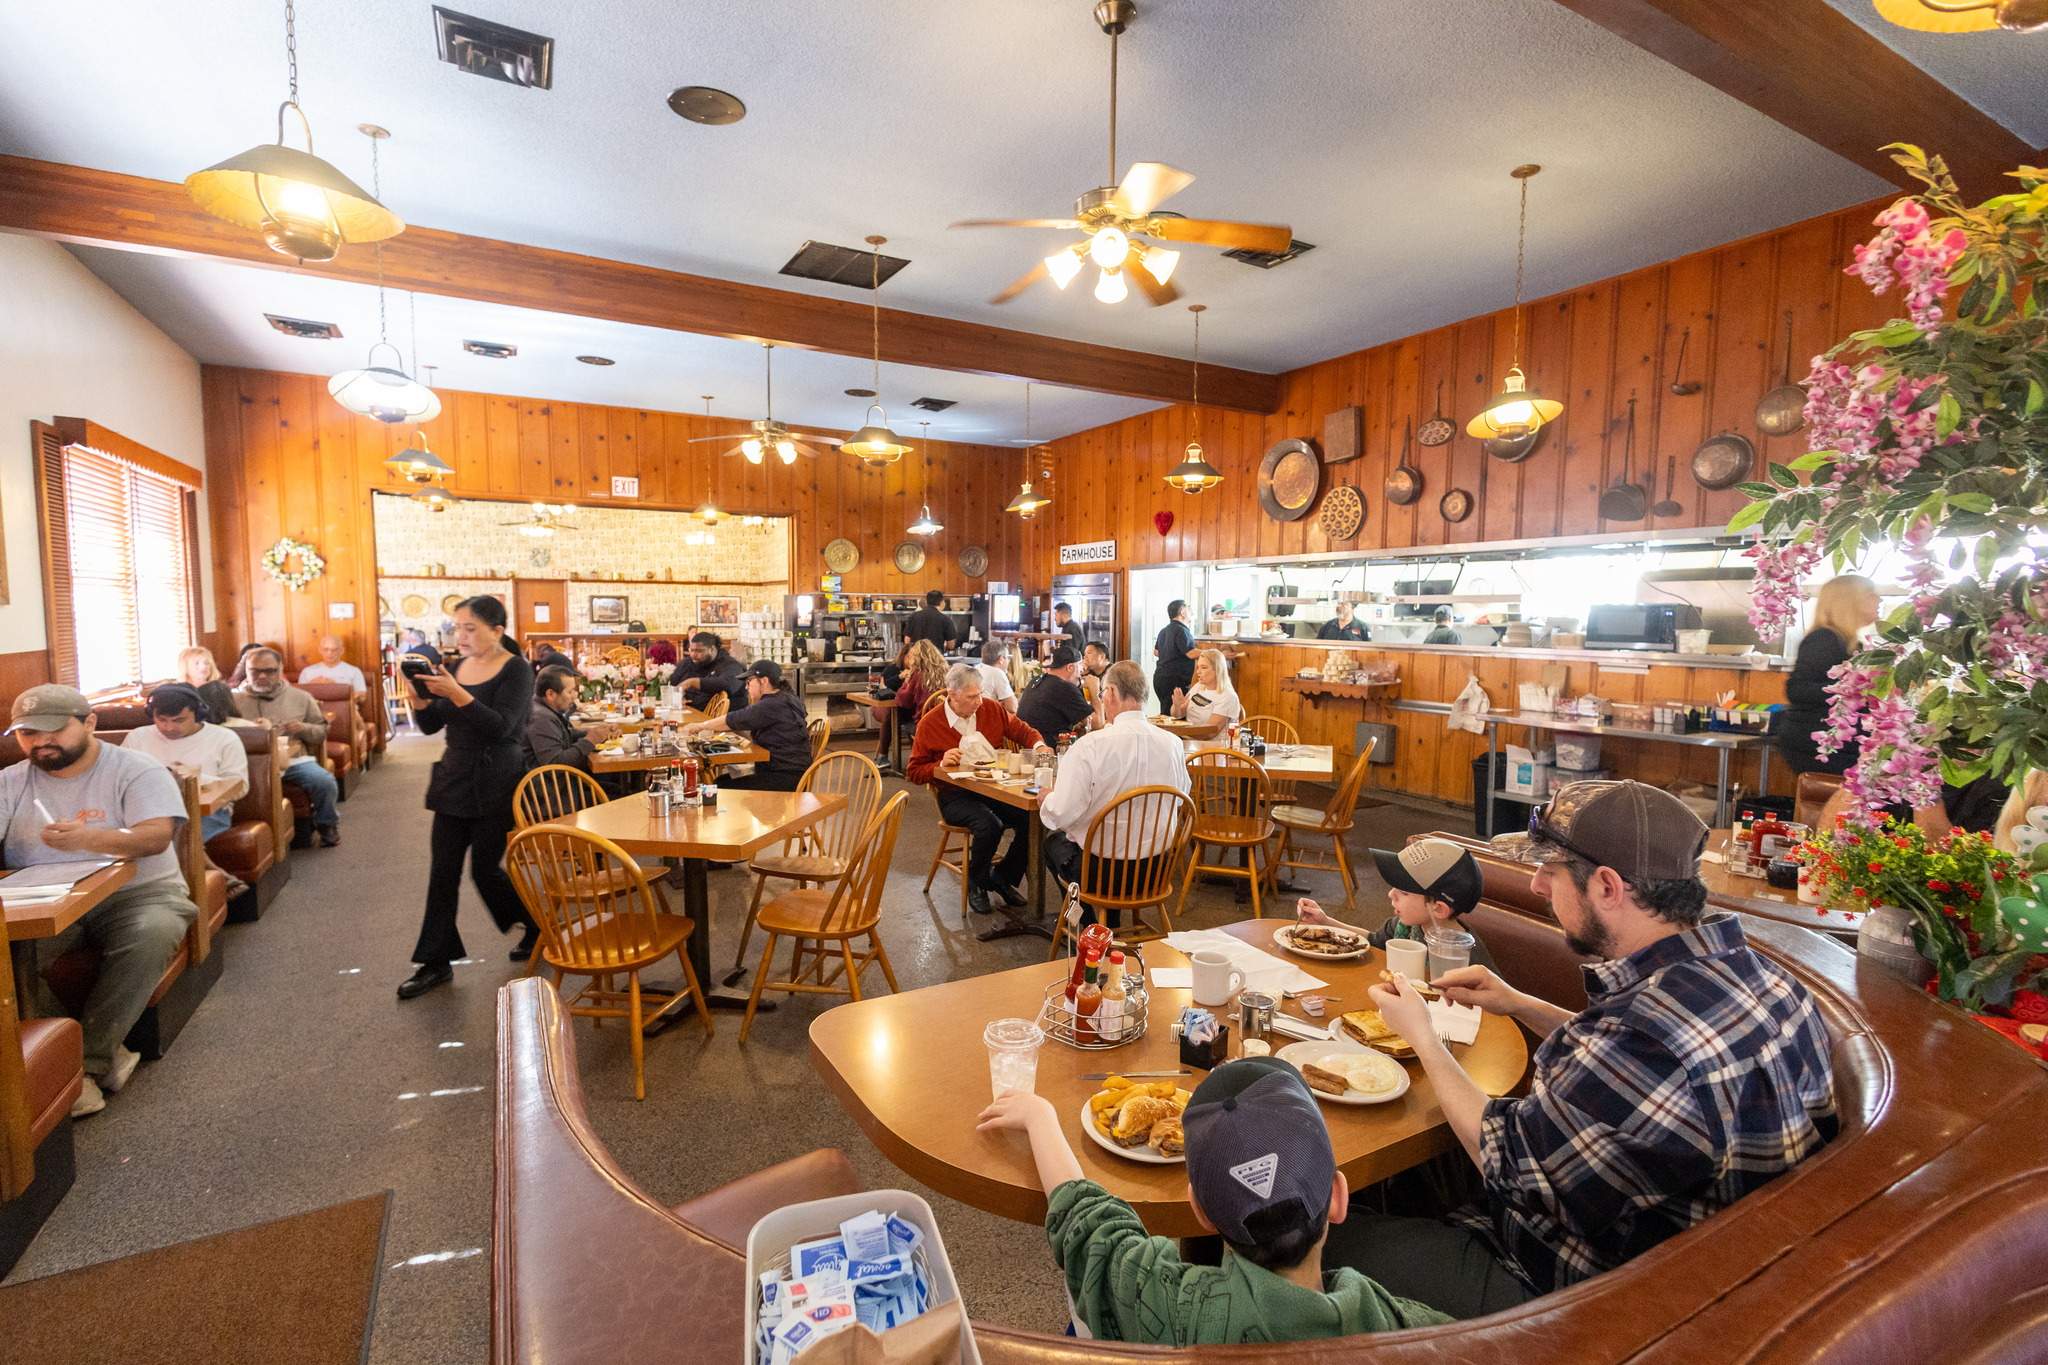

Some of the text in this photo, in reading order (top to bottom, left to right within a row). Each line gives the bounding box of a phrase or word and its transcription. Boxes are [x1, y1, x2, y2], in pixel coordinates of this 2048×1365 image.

[614, 479, 637, 495] EXIT
[1061, 545, 1114, 562] FARMHOUSE
[551, 568, 569, 578] EXIT
